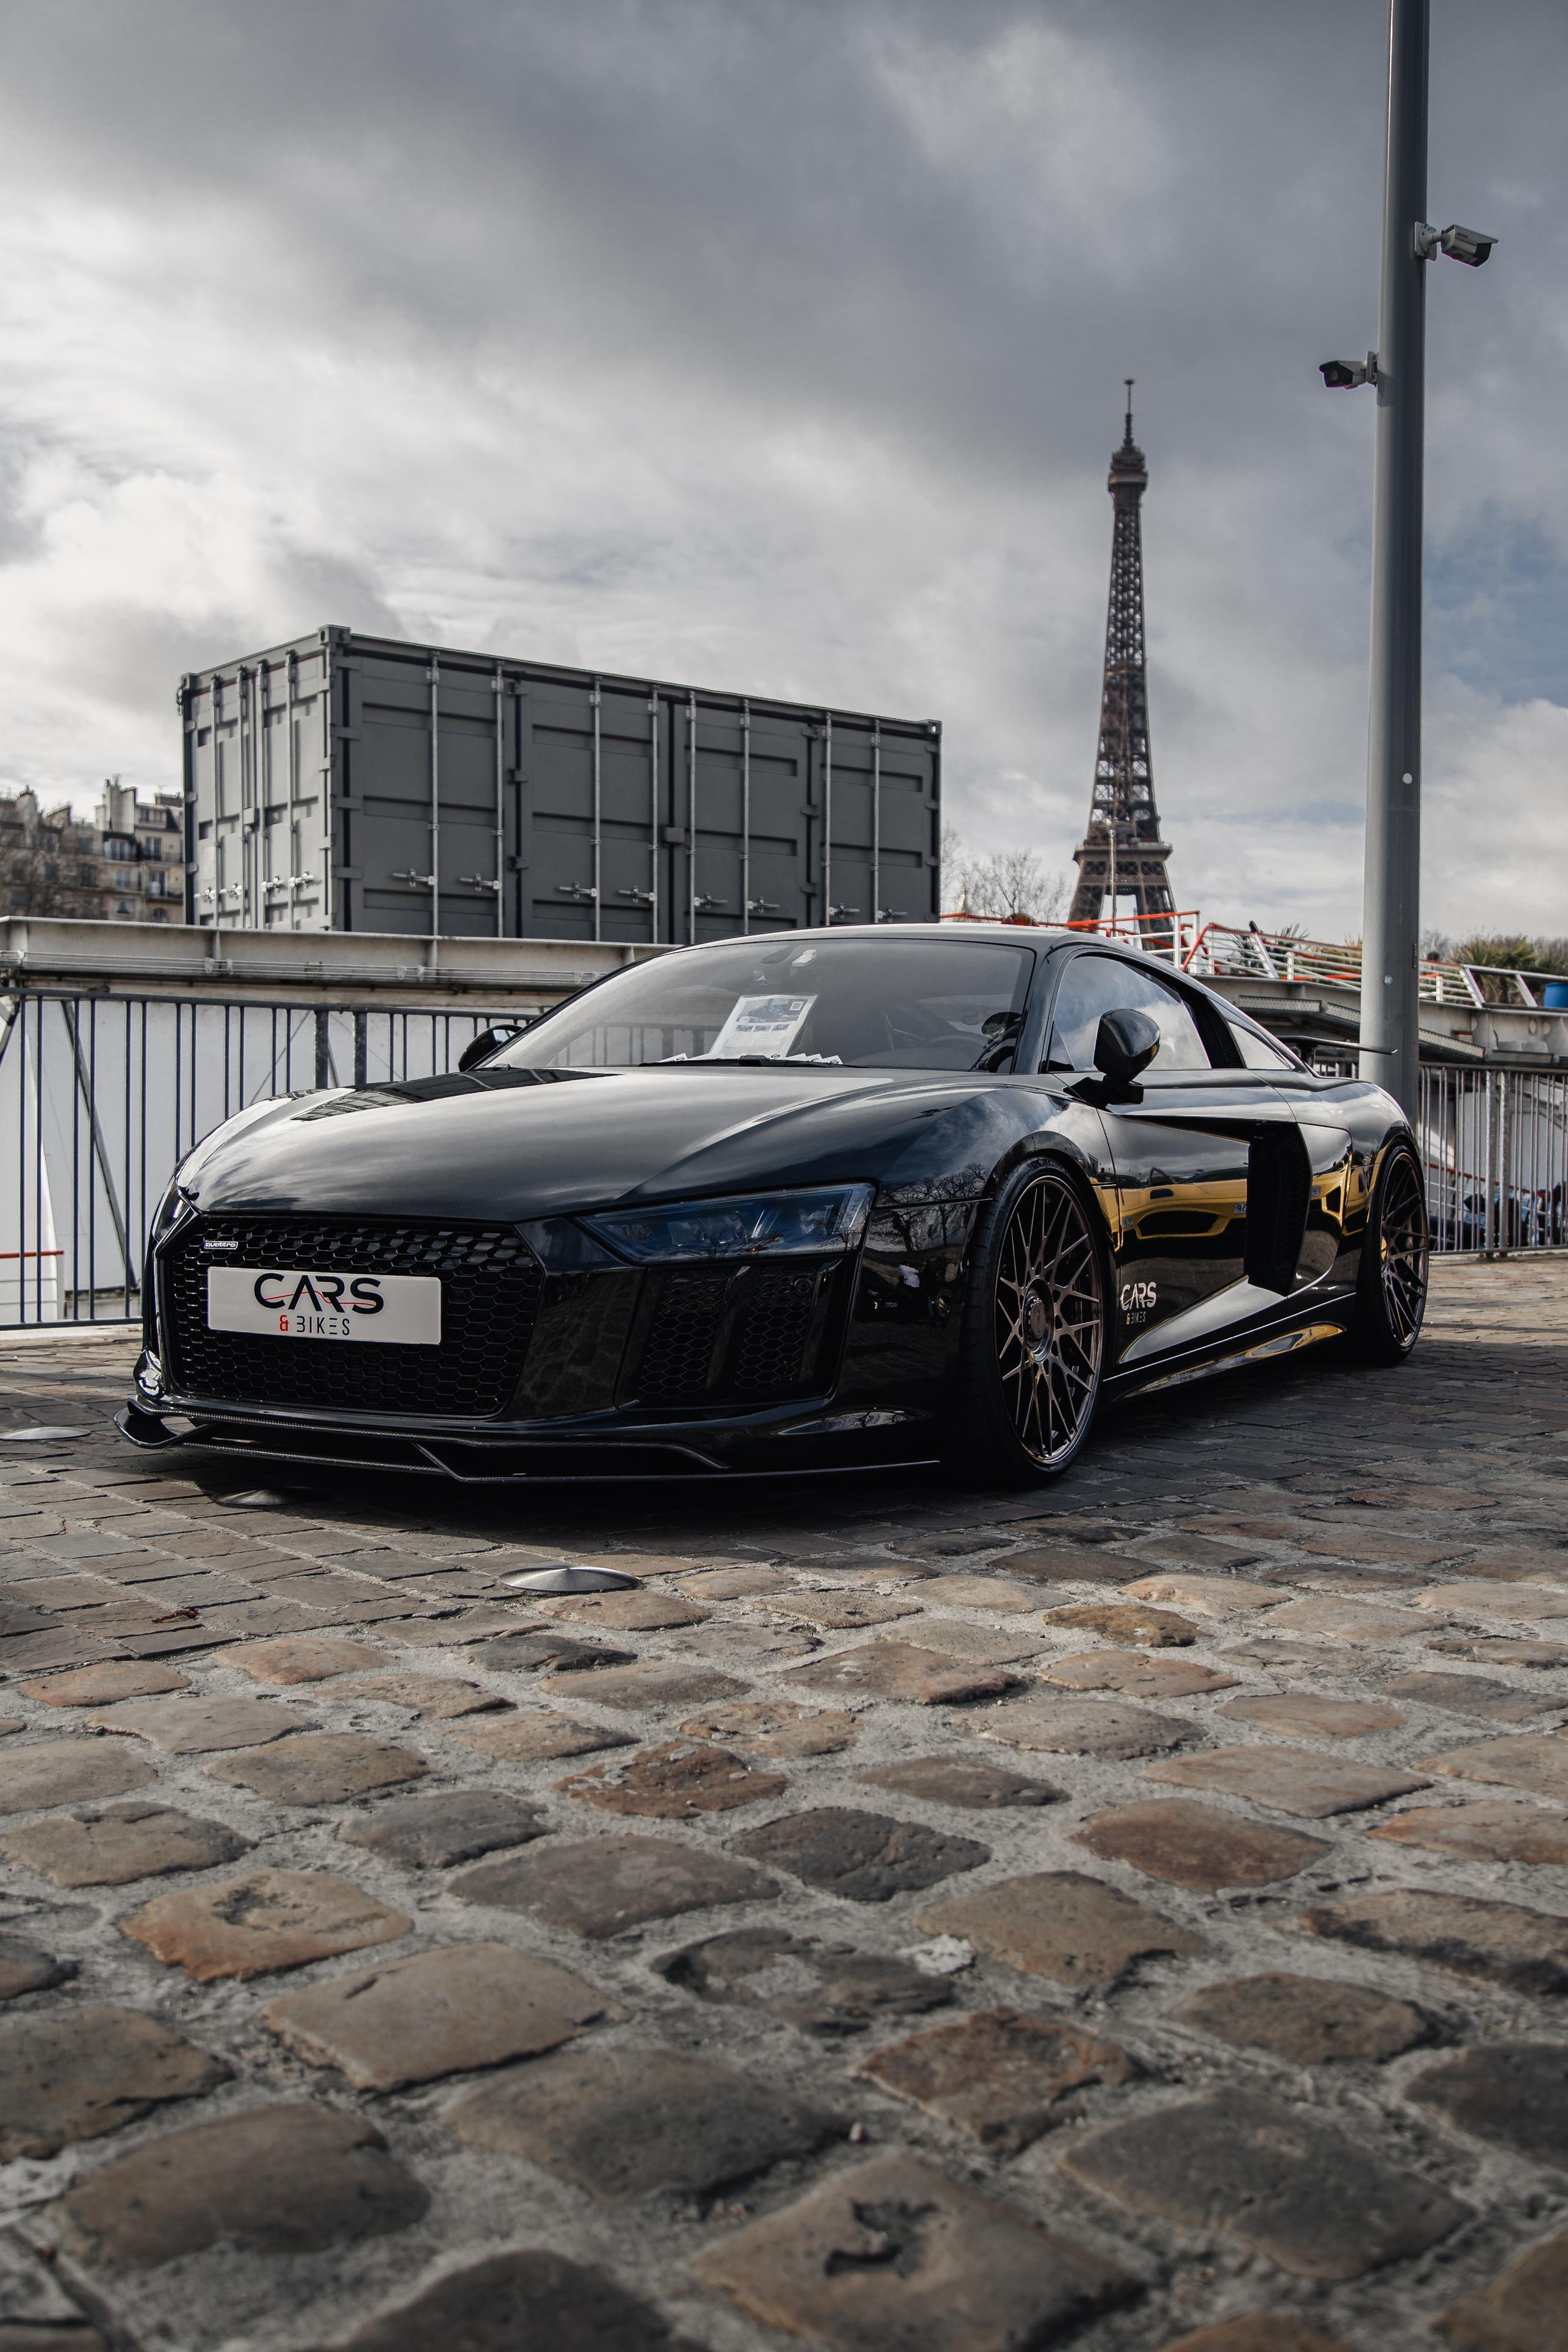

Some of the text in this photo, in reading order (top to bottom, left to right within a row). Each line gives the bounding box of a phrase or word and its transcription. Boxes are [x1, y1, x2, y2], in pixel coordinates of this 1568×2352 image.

[254, 1272, 384, 1314] CARS
[1121, 1281, 1156, 1311] CARS
[279, 1314, 350, 1335] & BIKES
